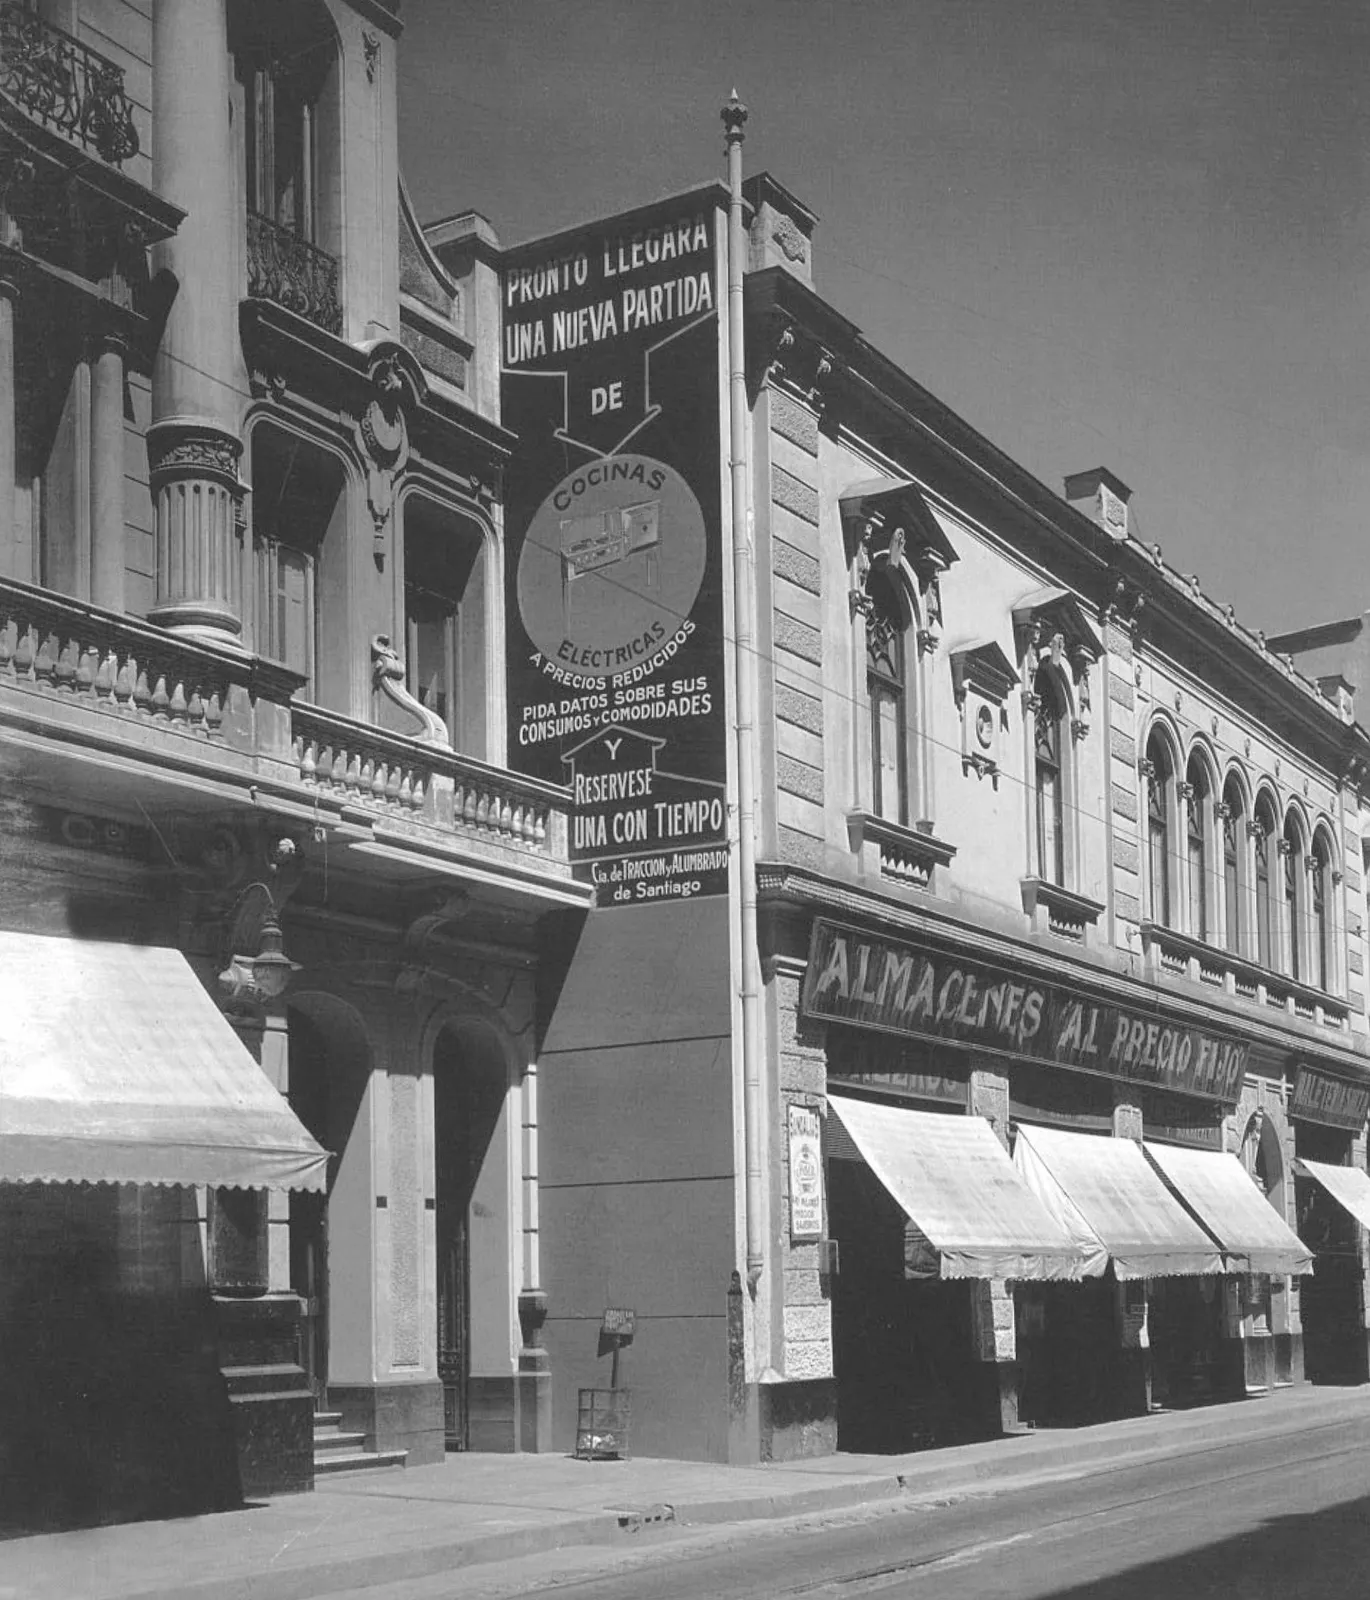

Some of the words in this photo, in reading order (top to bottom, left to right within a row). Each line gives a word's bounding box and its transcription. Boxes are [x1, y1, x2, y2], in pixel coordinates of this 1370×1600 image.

[507, 253, 589, 307] PRONTO
[604, 214, 708, 278] LLEGARA
[506, 320, 547, 364] UNA
[552, 299, 618, 352] NUEVA
[623, 271, 713, 333] PARTIDA
[591, 381, 623, 416] DE
[553, 462, 667, 512] COCINAS
[529, 652, 542, 668] A
[543, 662, 606, 691] PRECIOS
[613, 619, 696, 689] REDUCIDOS
[519, 713, 592, 746] CONSUMOS
[601, 694, 712, 724] COMODIDADES
[523, 702, 557, 721] PIDA
[560, 693, 608, 715] DATOS
[614, 683, 666, 705] SOBRE
[671, 676, 708, 695] SUS
[604, 738, 623, 760] Y
[575, 767, 653, 805] RESERVESE
[574, 815, 608, 849] UNA
[612, 808, 648, 843] CON
[653, 798, 723, 838] TIEMPO
[621, 859, 666, 880] TRACCION
[672, 850, 728, 874] ALUMBRADO
[613, 885, 632, 901] de
[635, 880, 701, 899] Santiago
[812, 937, 1044, 1044] ALMACENES
[1108, 1013, 1192, 1075] PRECIO
